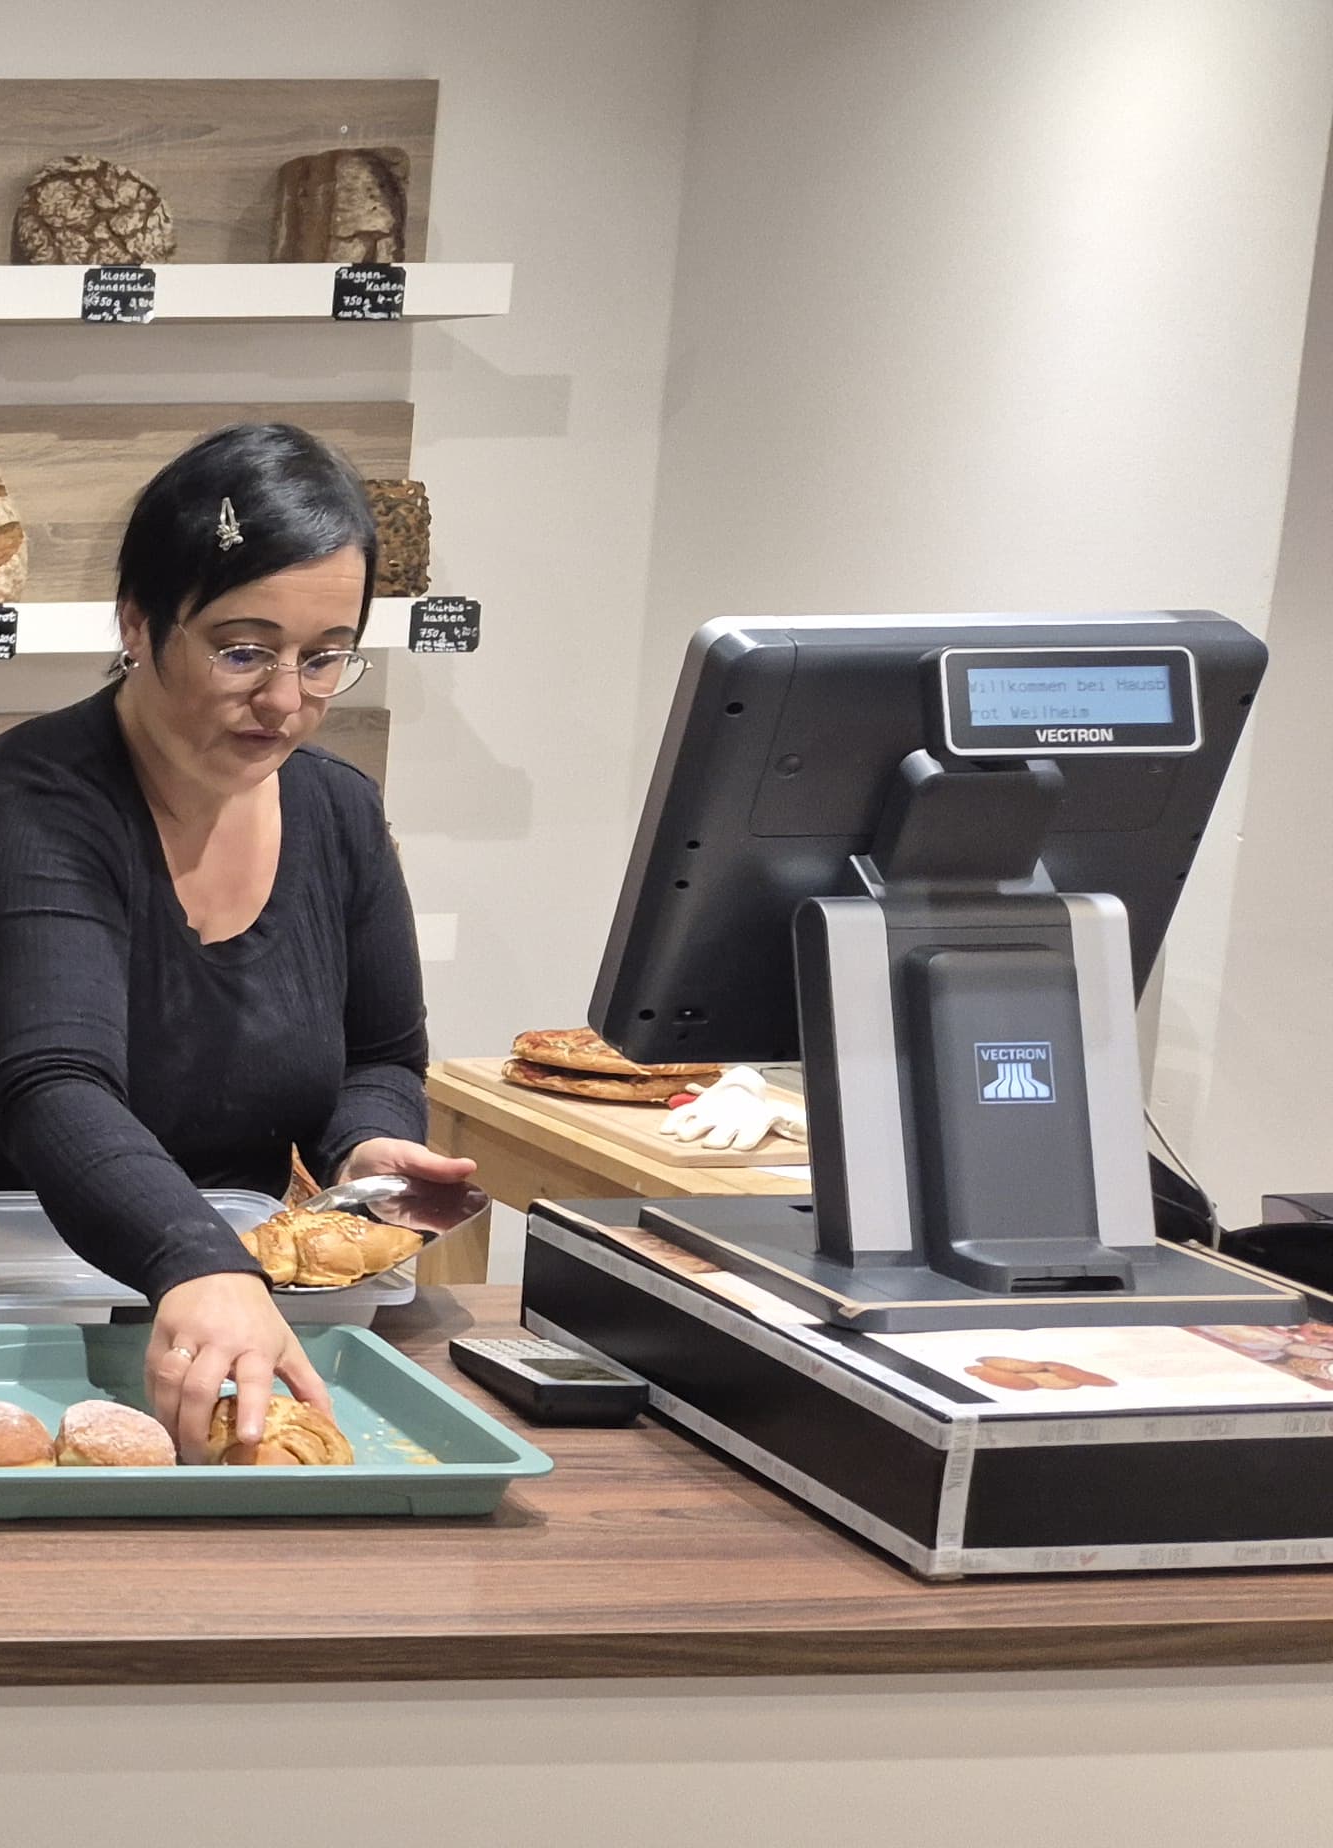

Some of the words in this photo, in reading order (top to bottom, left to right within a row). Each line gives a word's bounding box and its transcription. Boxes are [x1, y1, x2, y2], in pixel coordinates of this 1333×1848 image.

[1076, 677, 1106, 692] bei
[1011, 705, 1091, 720] Weilheim
[1036, 728, 1113, 743] VECTRON
[980, 1048, 1046, 1061] VECTRON
